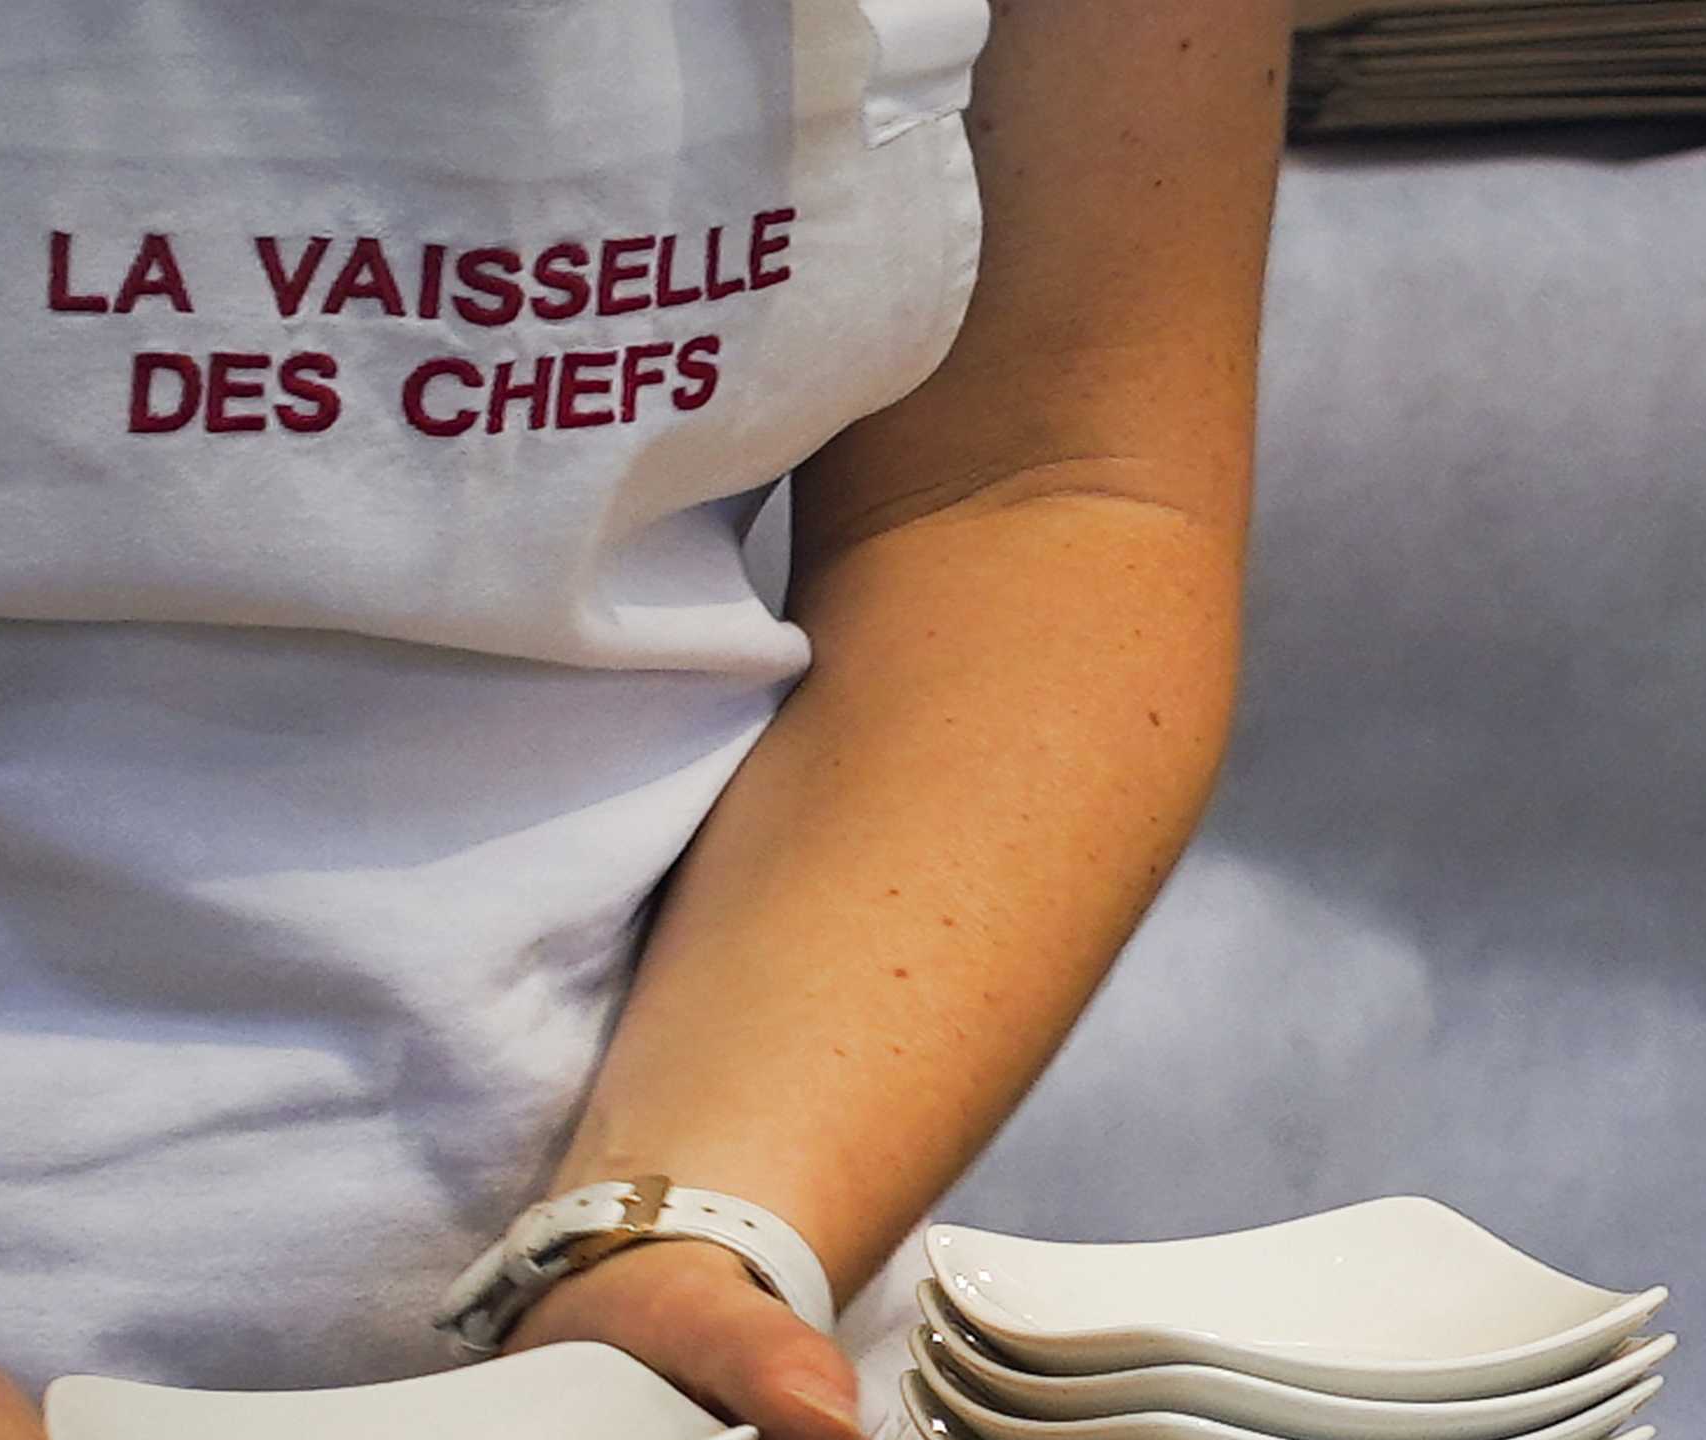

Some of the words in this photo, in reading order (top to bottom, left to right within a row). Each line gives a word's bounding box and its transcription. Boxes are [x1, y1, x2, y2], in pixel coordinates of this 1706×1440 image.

[47, 231, 194, 314] LA
[255, 207, 797, 326] VAISSELLE
[128, 351, 342, 434] DES
[402, 334, 722, 438] CHEFS
